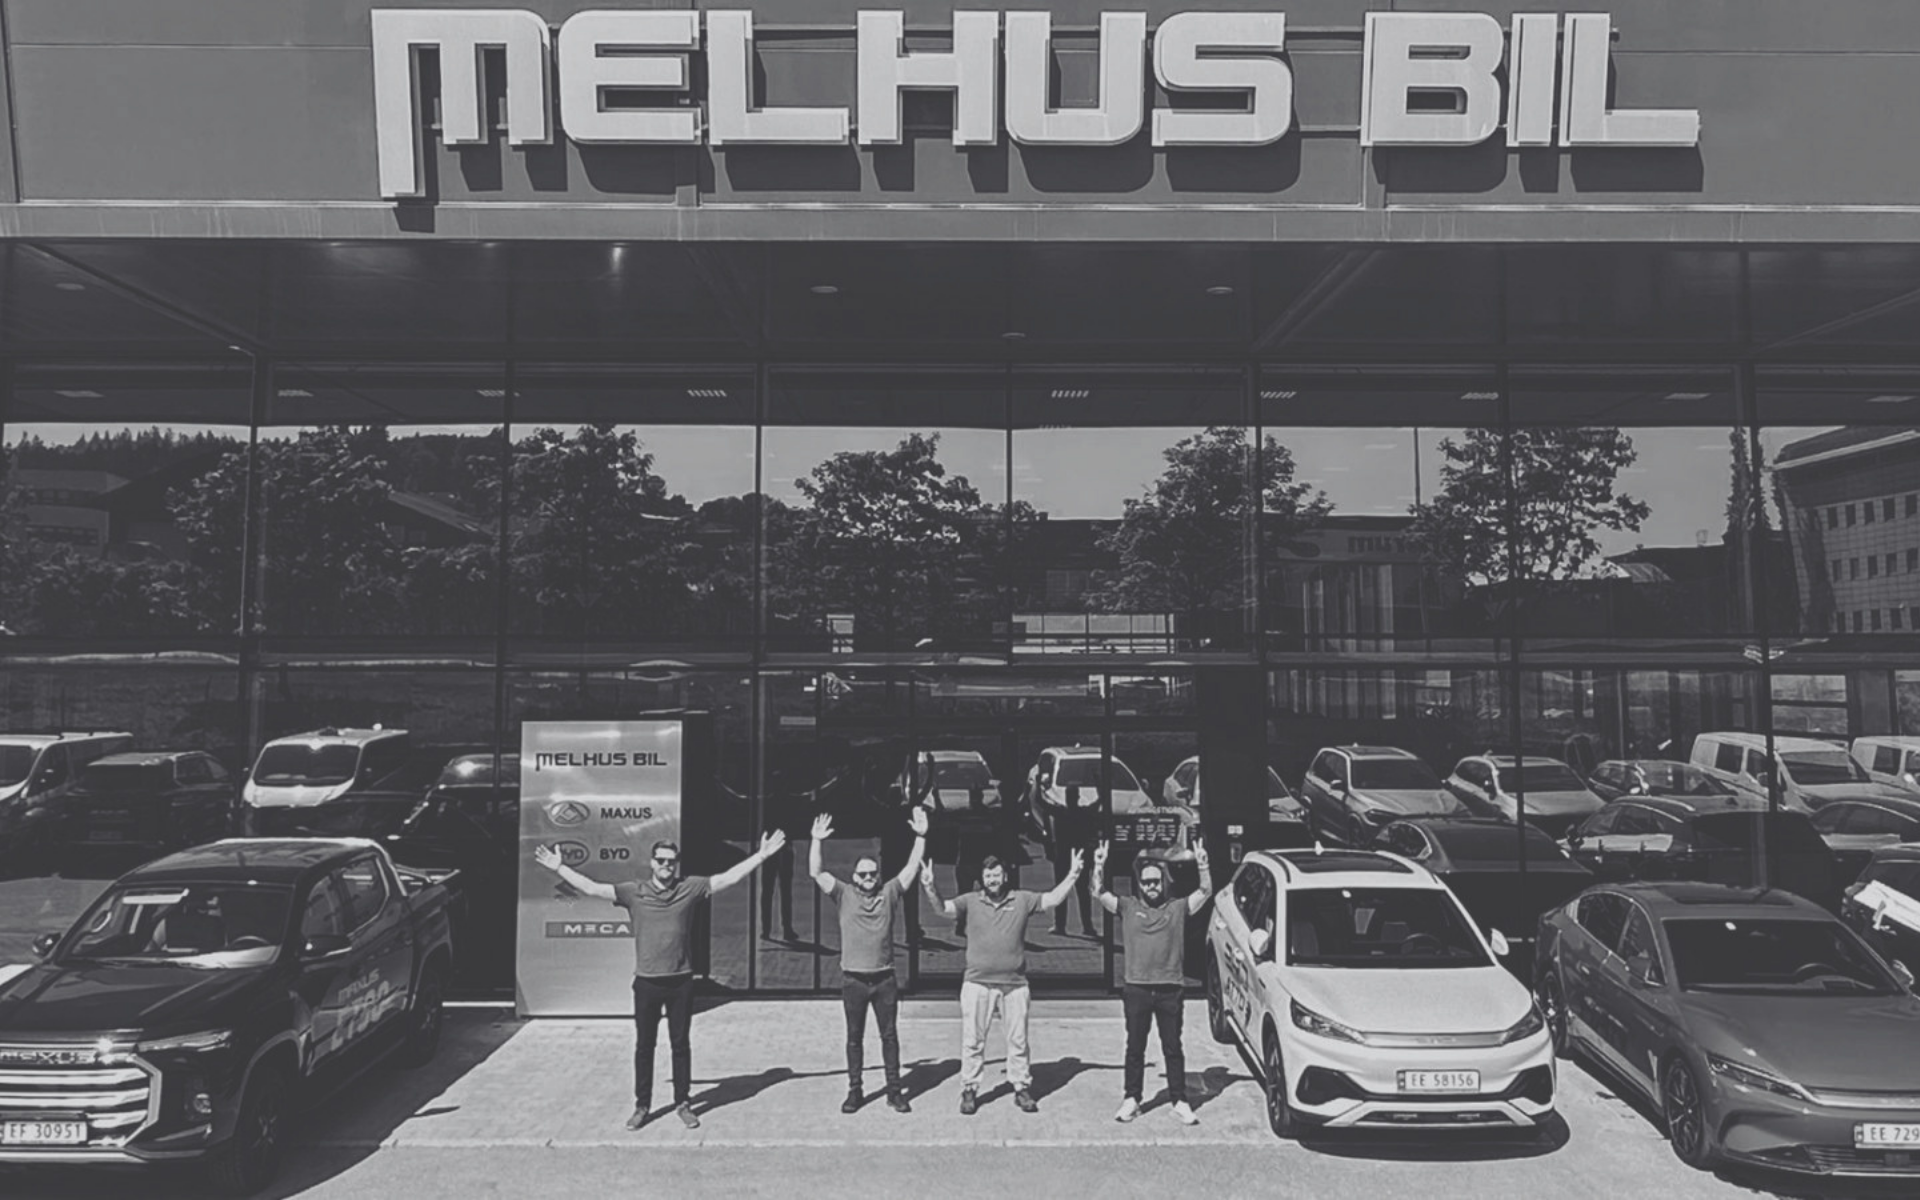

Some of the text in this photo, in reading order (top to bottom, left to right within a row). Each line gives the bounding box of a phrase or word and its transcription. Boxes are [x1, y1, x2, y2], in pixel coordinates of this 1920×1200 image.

[371, 9, 1699, 197] MELHUS BIL
[535, 752, 667, 771] MELHUS BIL
[600, 807, 652, 819] MAXUS
[600, 848, 630, 860] BYD
[1411, 1073, 1474, 1087] EE 58156
[9, 1123, 81, 1138] EF 30951
[1869, 1127, 1887, 1141] EE
